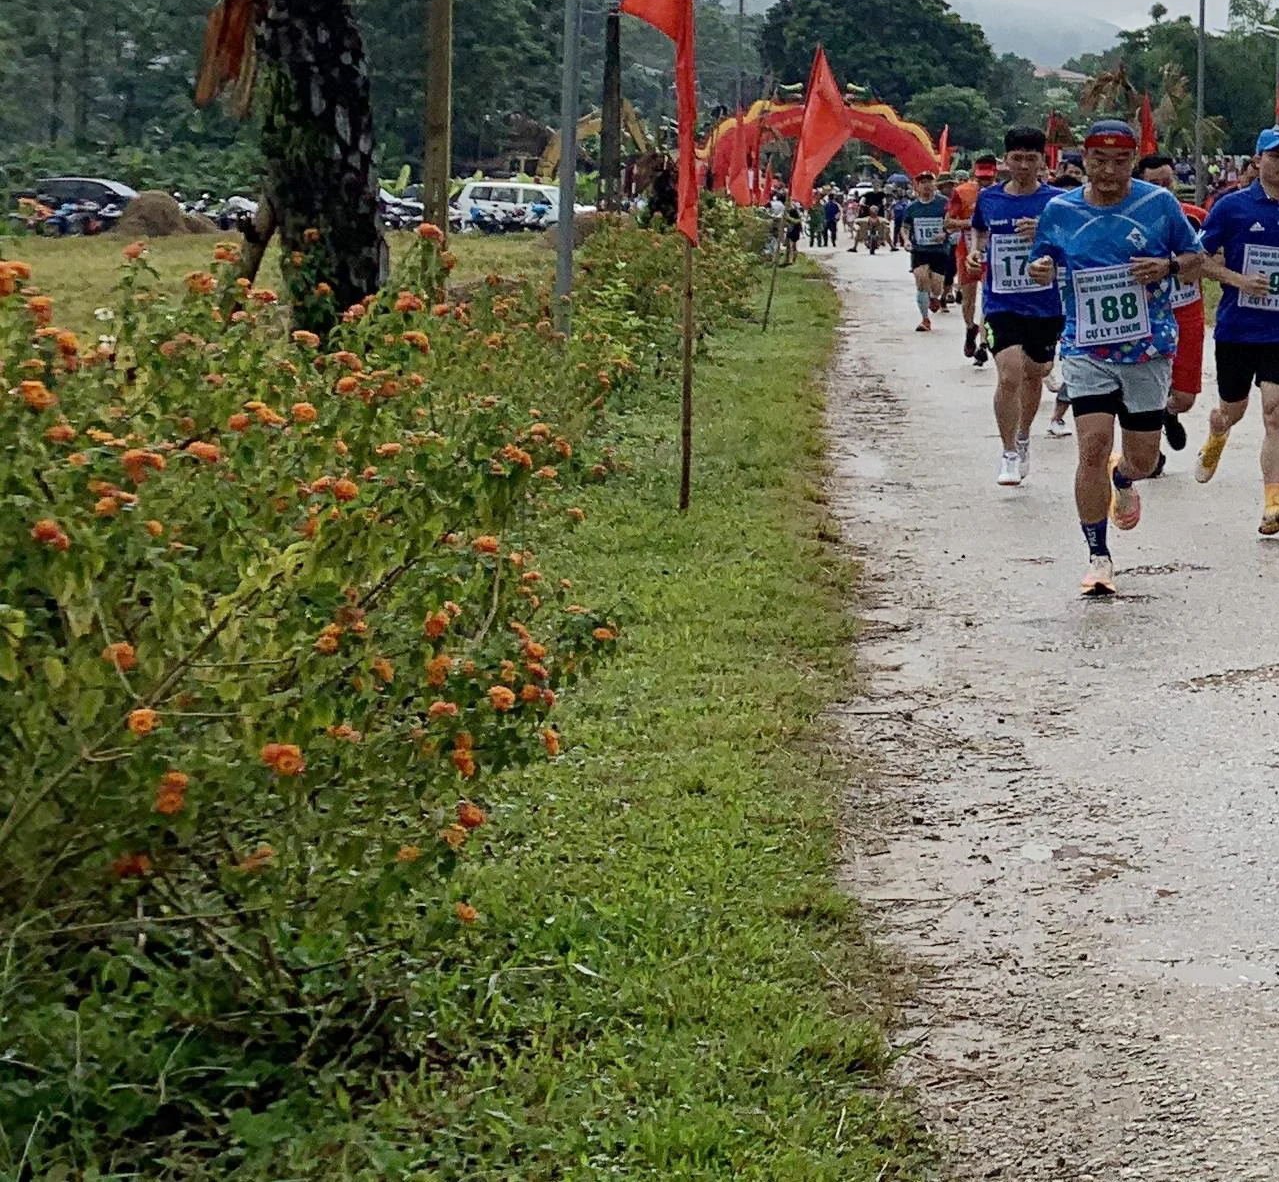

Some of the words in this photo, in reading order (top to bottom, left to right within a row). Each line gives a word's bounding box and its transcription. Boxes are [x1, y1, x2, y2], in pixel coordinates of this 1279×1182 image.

[1001, 255, 1029, 277] 17
[1085, 292, 1139, 325] 188
[1100, 326, 1111, 338] LY
